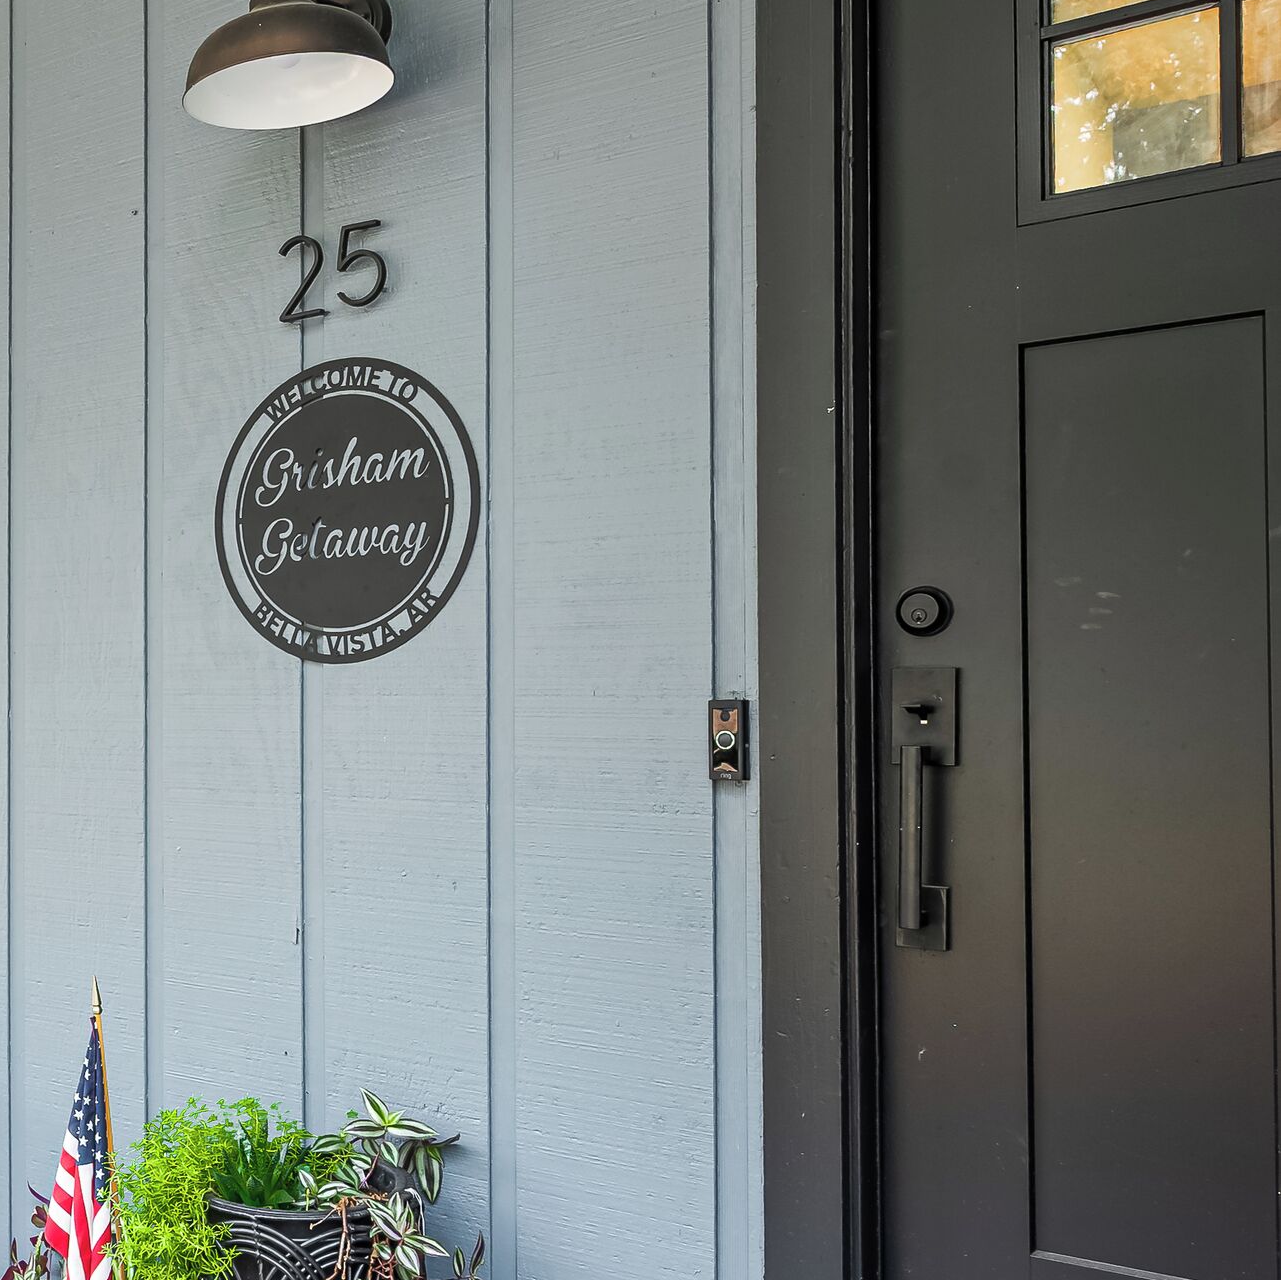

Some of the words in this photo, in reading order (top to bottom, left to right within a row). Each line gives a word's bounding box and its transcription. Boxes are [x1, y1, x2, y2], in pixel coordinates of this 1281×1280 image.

[278, 219, 388, 322] 25
[265, 366, 387, 422] WELCOME
[387, 370, 418, 404] TO
[255, 436, 430, 507] Grisham
[255, 517, 430, 576] Getaway
[252, 600, 321, 655] BELLA
[406, 586, 441, 625] AR
